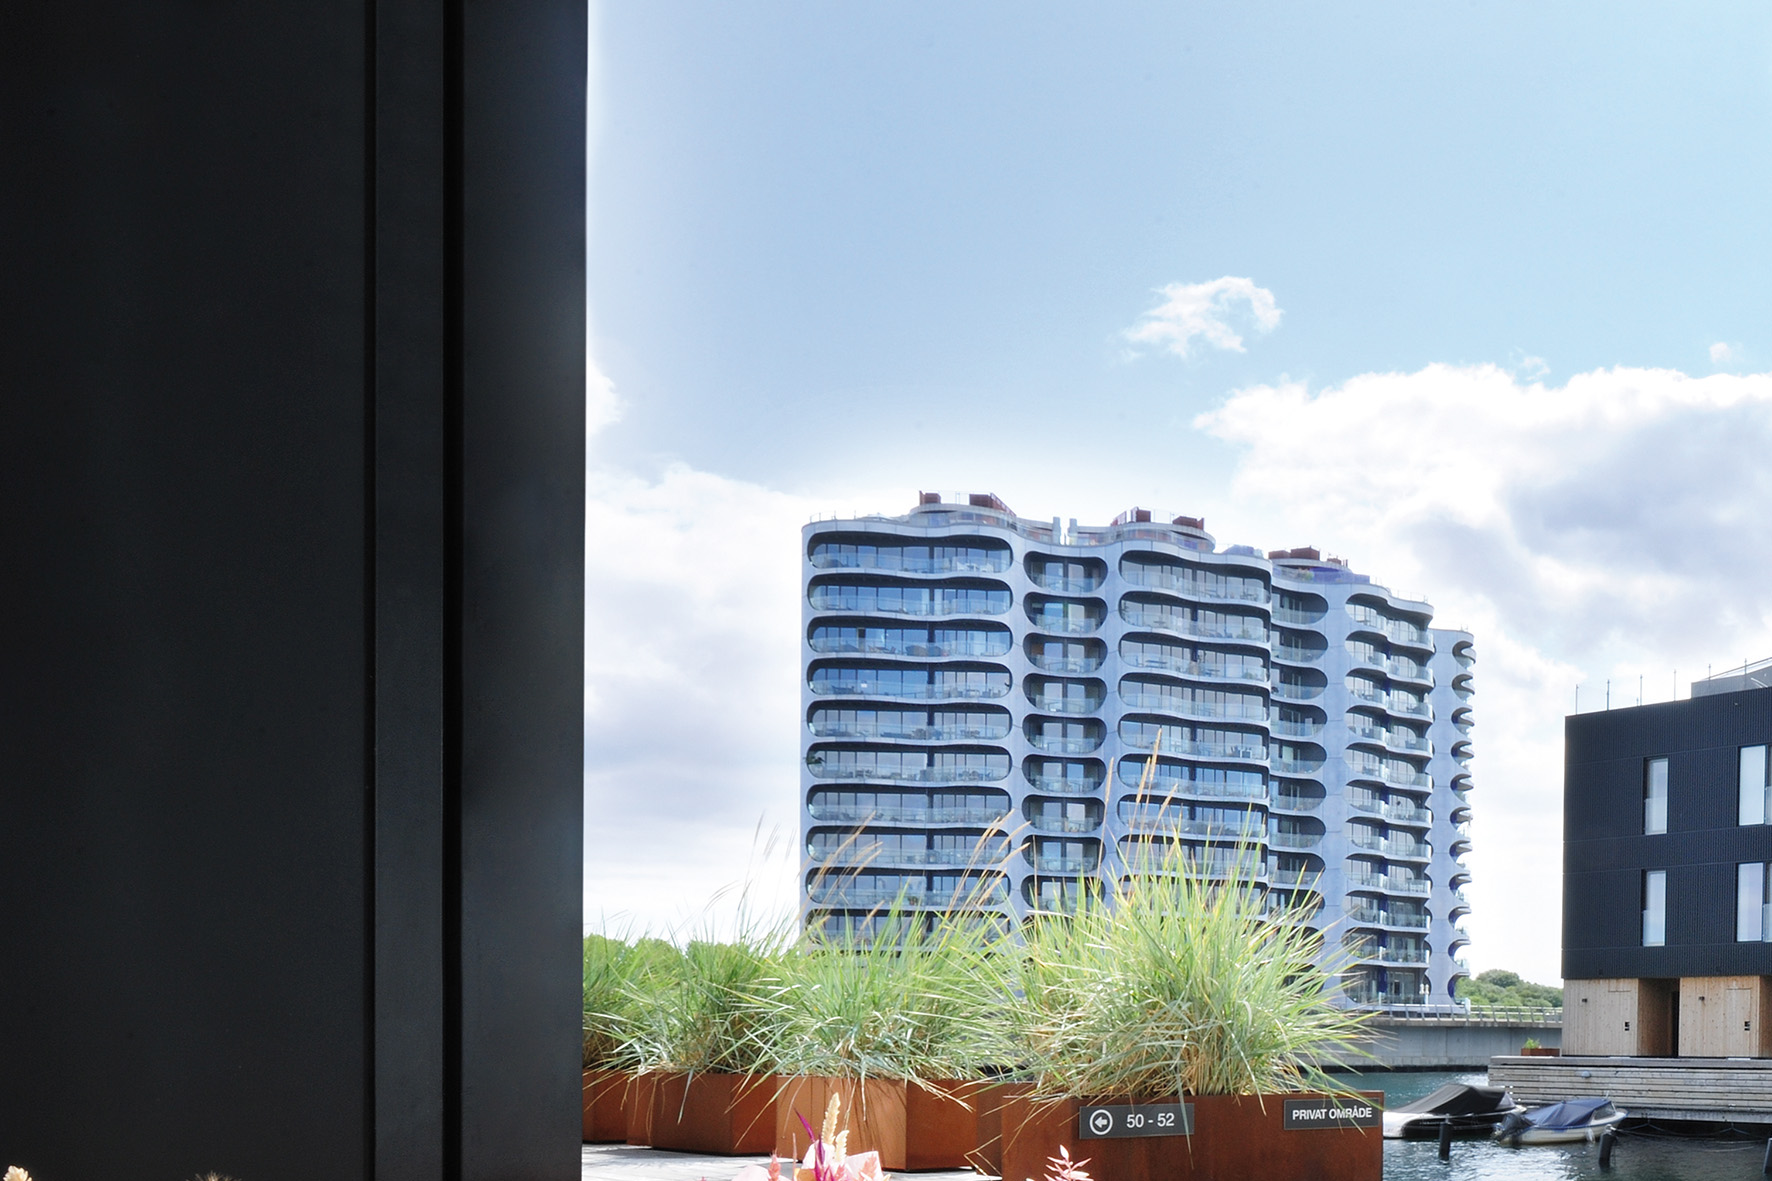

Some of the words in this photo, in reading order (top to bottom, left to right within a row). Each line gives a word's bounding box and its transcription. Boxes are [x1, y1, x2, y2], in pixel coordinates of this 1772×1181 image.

[1126, 1113, 1145, 1128] 50
[1157, 1112, 1175, 1127] 52
[1292, 1109, 1327, 1120] PRIVAT
[1328, 1105, 1373, 1119] OMRÅDE
